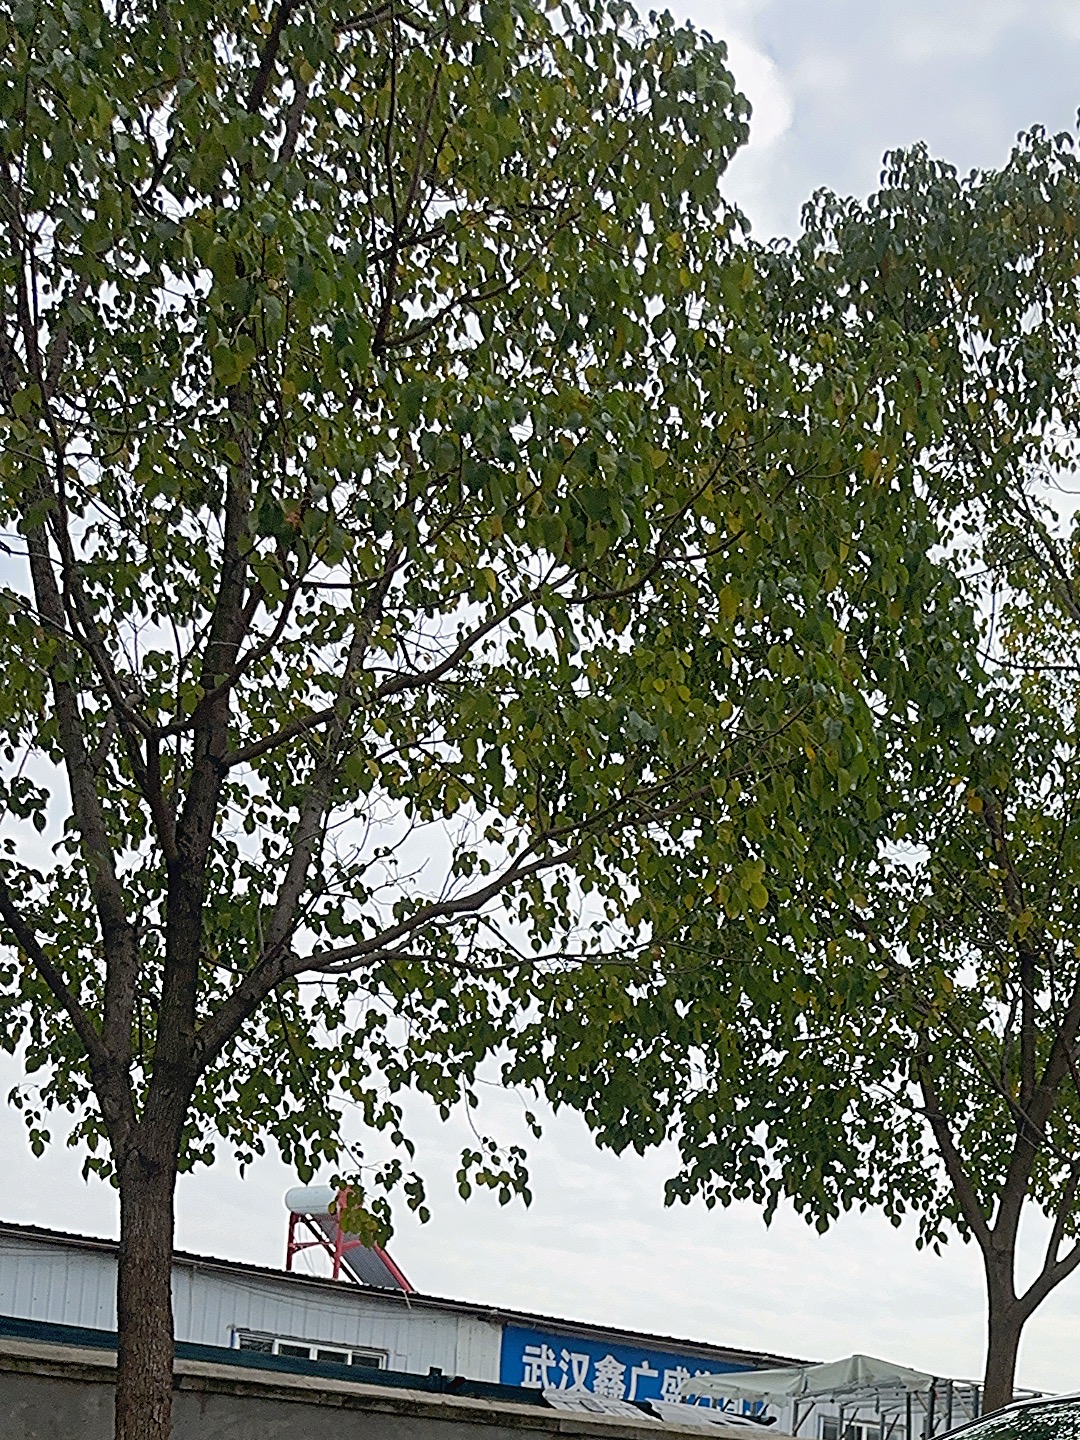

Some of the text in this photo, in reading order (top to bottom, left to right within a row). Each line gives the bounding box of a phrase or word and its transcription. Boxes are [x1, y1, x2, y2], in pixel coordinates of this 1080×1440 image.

[520, 1344, 766, 1414] 武汉鑫广盛
